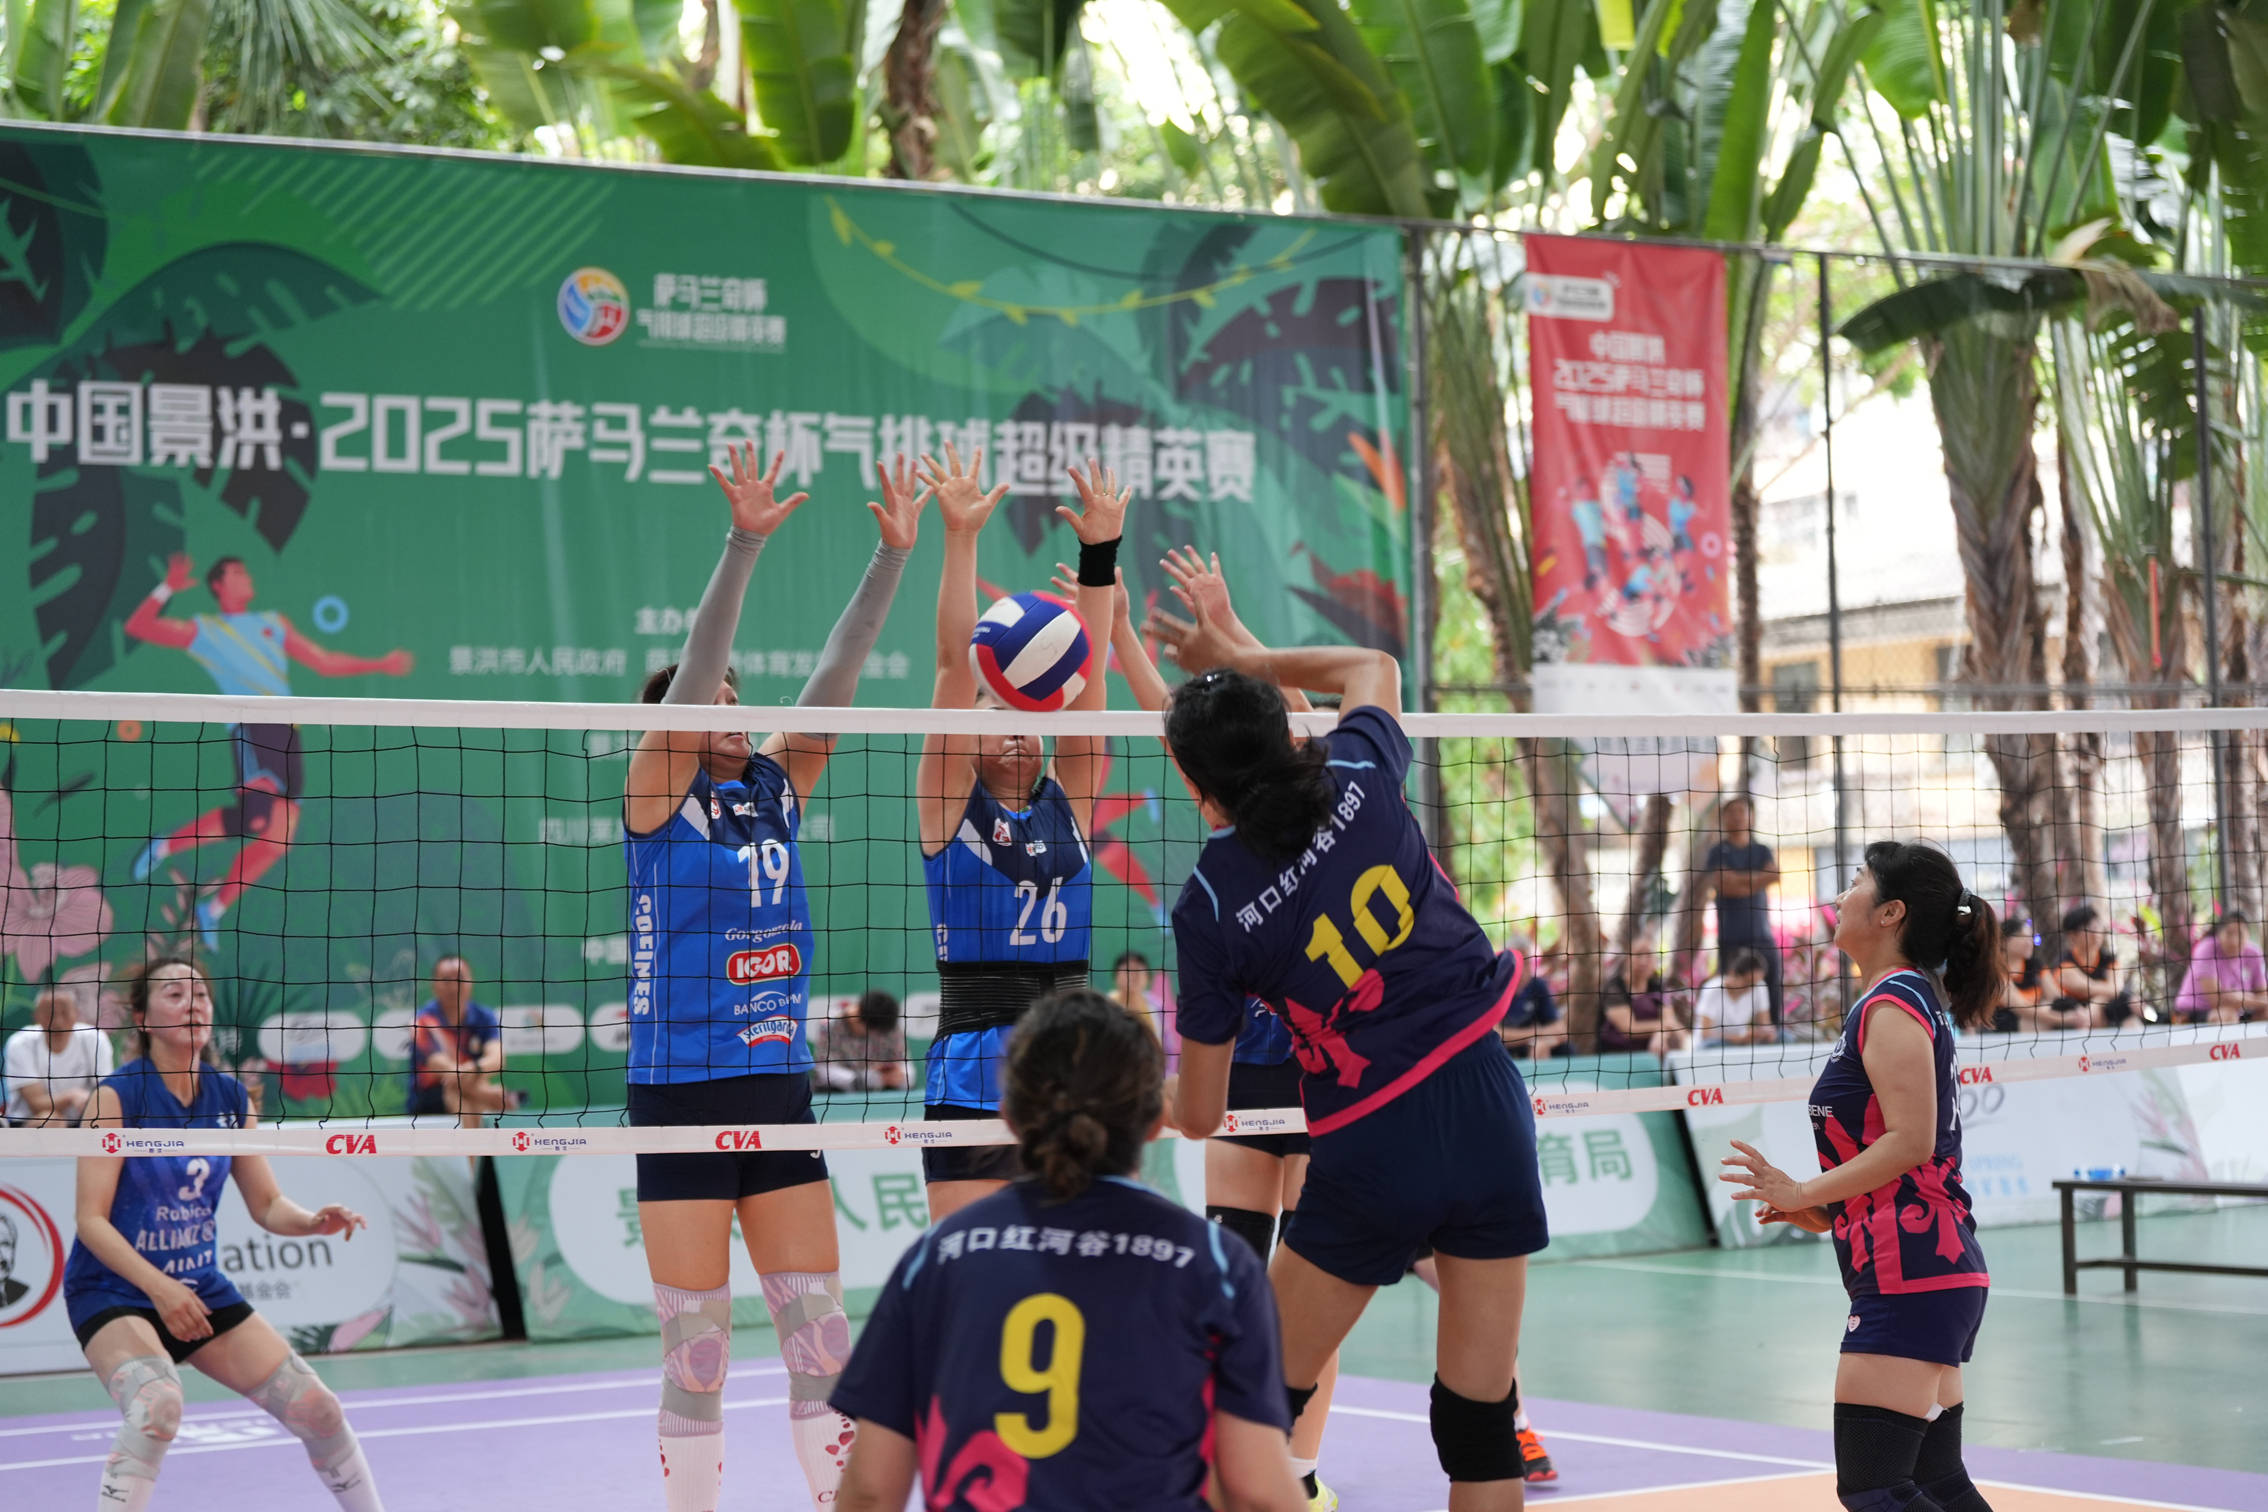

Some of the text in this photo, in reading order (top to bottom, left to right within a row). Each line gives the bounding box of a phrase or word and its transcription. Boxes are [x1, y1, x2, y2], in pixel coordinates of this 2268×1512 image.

[737, 839, 790, 909] 19
[1009, 876, 1068, 946] 26
[1304, 864, 1415, 990] 10
[736, 949, 793, 979] IGOR
[733, 999, 778, 1017] BANCO
[2209, 1043, 2241, 1061] CVA
[1960, 1066, 1993, 1085] CVA
[1687, 1087, 1724, 1107] CVA
[126, 1139, 184, 1148] HENGJIA
[325, 1133, 378, 1155] CVA
[534, 1138, 587, 1146] HENGJIA
[715, 1130, 763, 1151] CVA
[904, 1130, 953, 1141] HENGJIA
[178, 1157, 210, 1201] 3
[936, 1223, 1196, 1269] 河口红河谷1897
[993, 1292, 1086, 1460] 9
